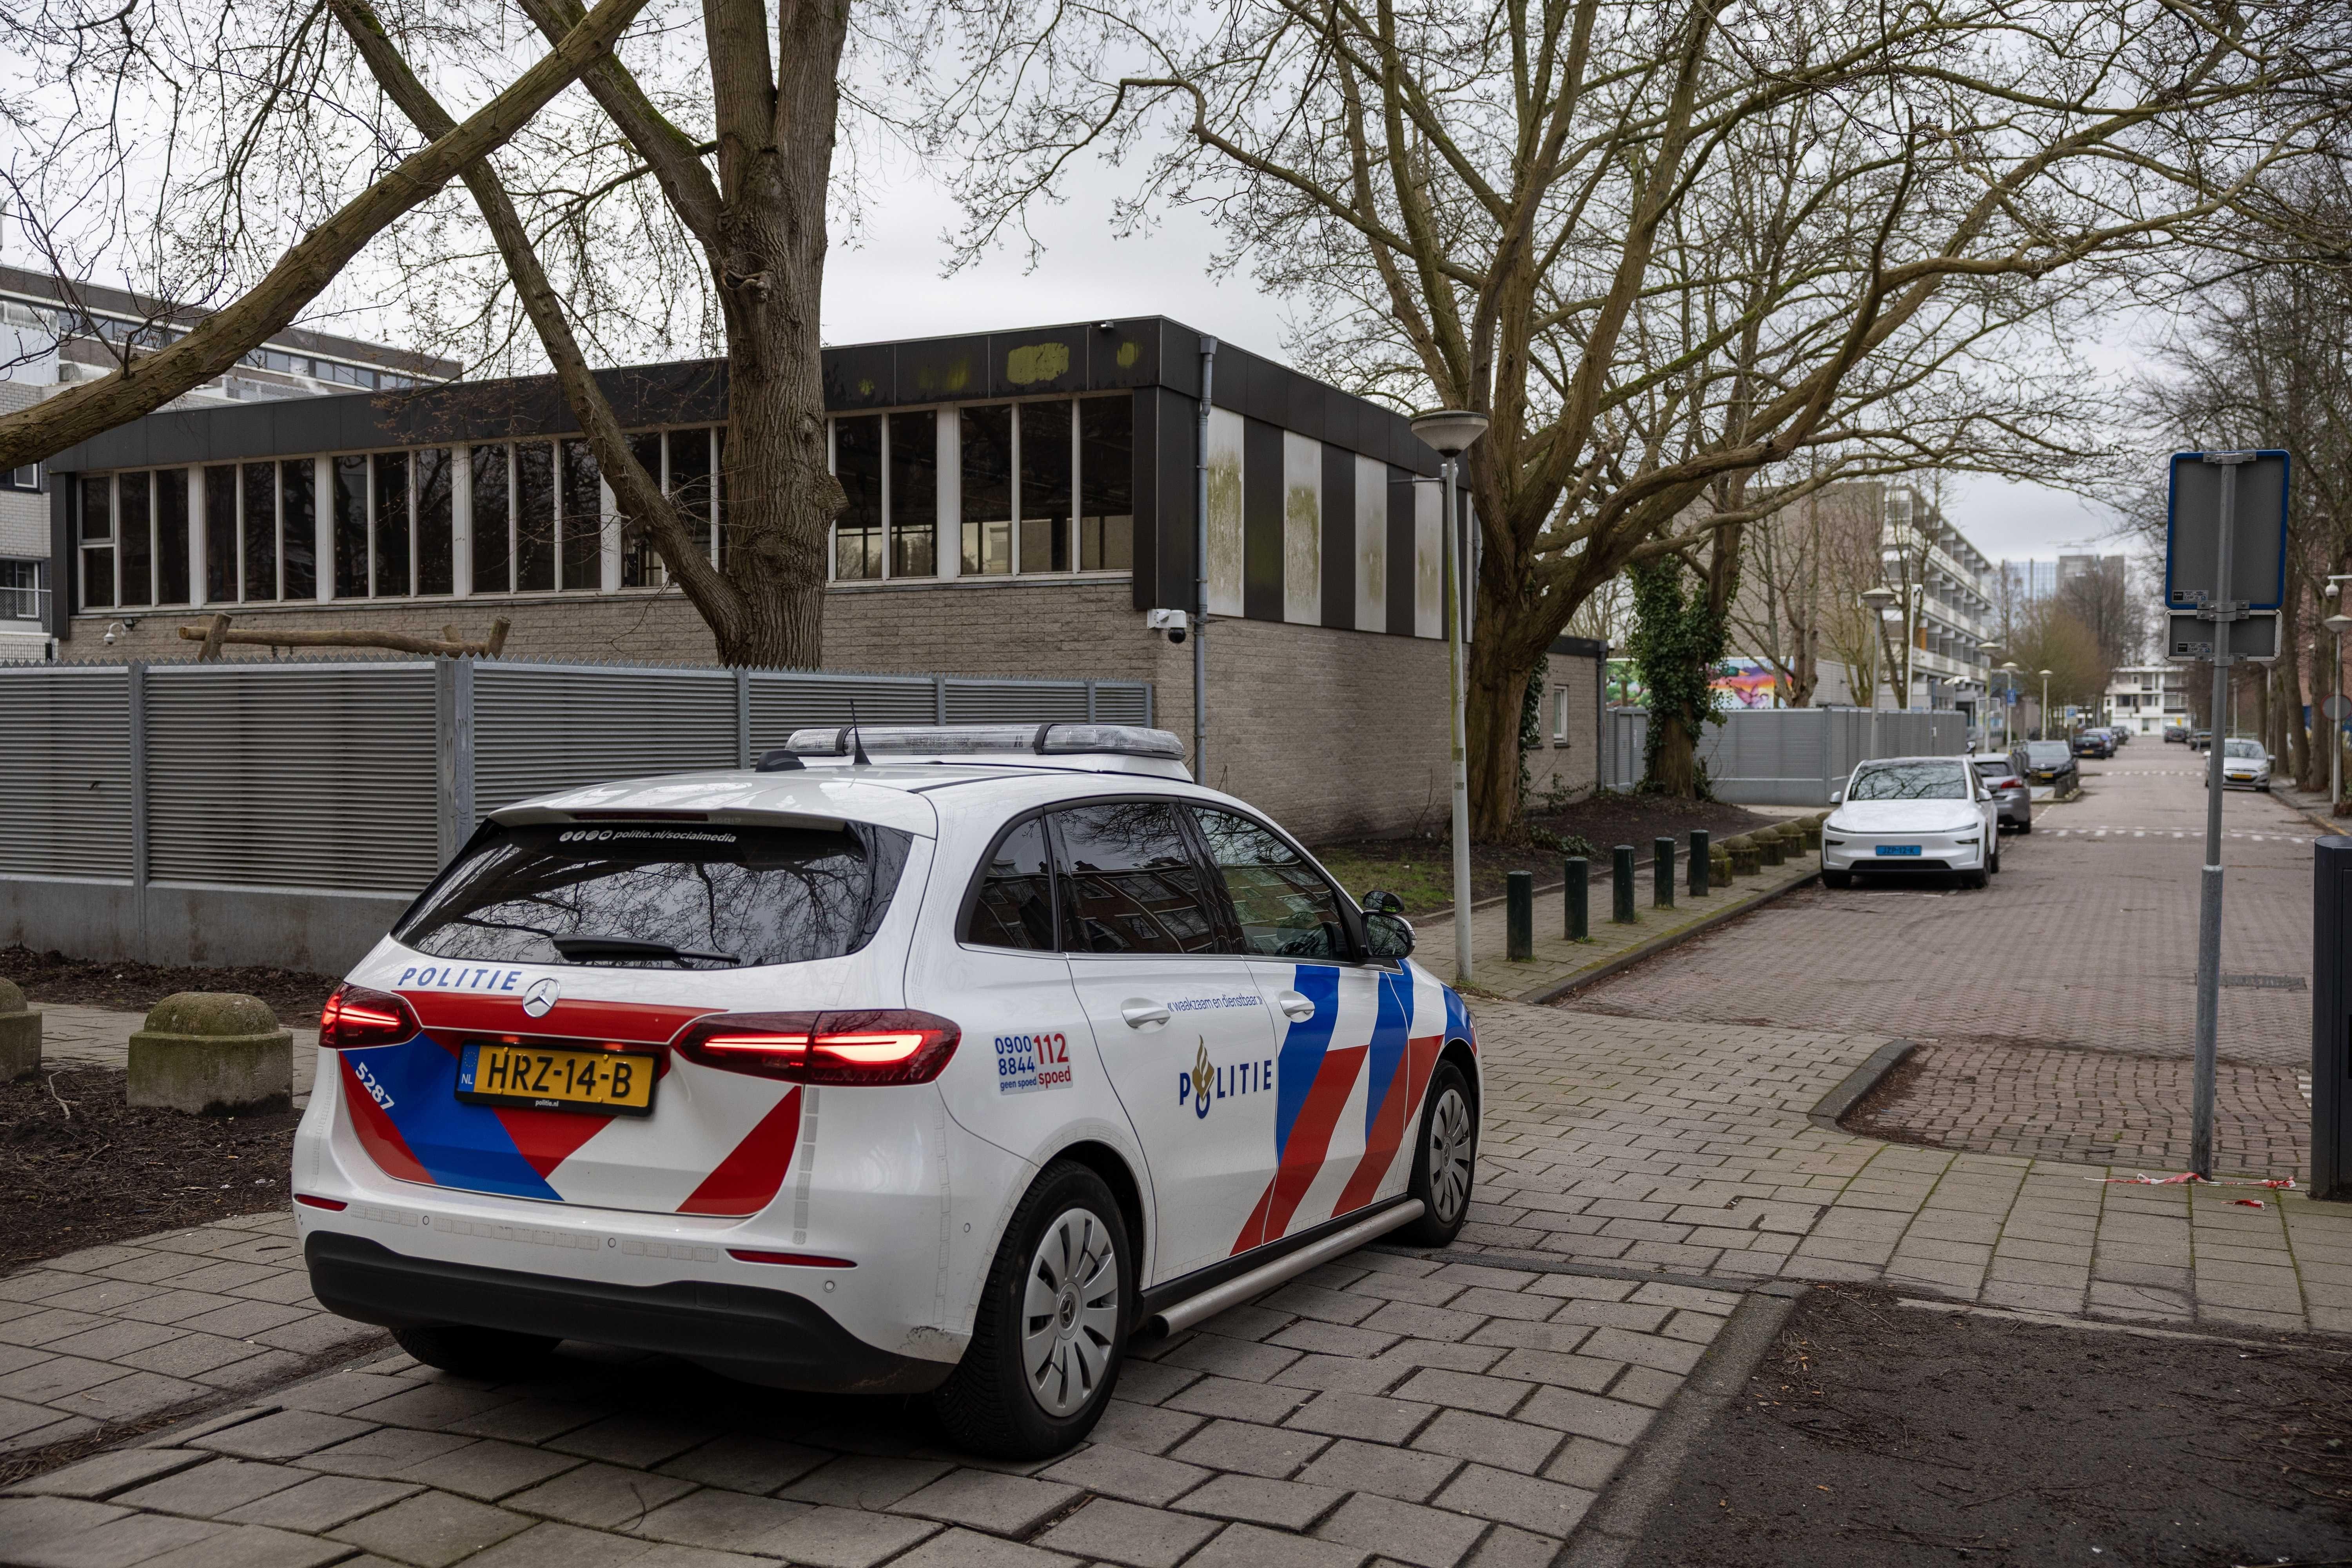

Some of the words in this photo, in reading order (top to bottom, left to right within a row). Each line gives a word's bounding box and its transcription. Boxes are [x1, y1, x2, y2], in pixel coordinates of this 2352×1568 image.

[613, 830, 736, 842] politie.nl/socialmedia
[398, 968, 522, 991] POLITIE
[1172, 997, 1213, 1011] waakzaam
[1214, 998, 1223, 1009] en
[995, 1036, 1032, 1054] 0900
[1033, 1033, 1069, 1065] 112
[487, 1053, 632, 1097] HRZ-14-B
[998, 1056, 1035, 1076] 8844
[355, 1062, 395, 1110] 5287
[461, 1074, 473, 1085] NL
[1000, 1081, 1016, 1091] geen
[1018, 1076, 1037, 1089] spoed
[1038, 1065, 1071, 1089] spoed
[1180, 1060, 1272, 1119] POLITIE
